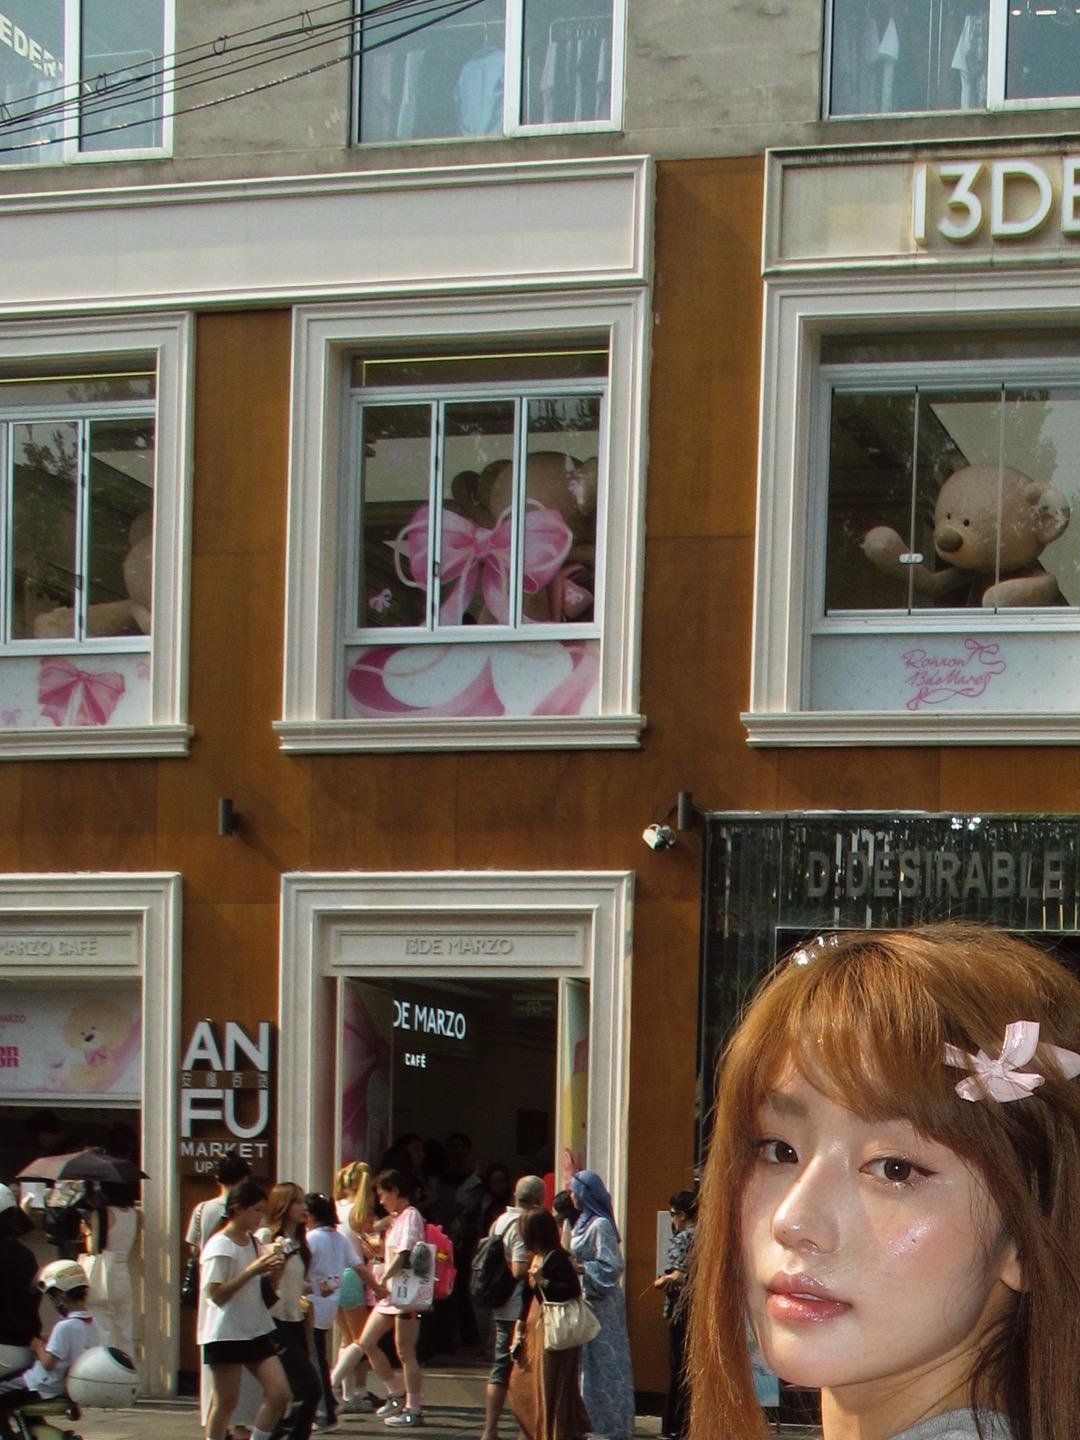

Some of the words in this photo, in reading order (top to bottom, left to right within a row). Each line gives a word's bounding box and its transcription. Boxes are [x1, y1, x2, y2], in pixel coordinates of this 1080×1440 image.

[448, 938, 514, 956] MARZO
[414, 1004, 467, 1040] MARZO
[181, 1021, 270, 1072] AN
[405, 1053, 427, 1068] CAFÉ
[181, 1088, 270, 1139] FU
[181, 1141, 268, 1158] MARKET
